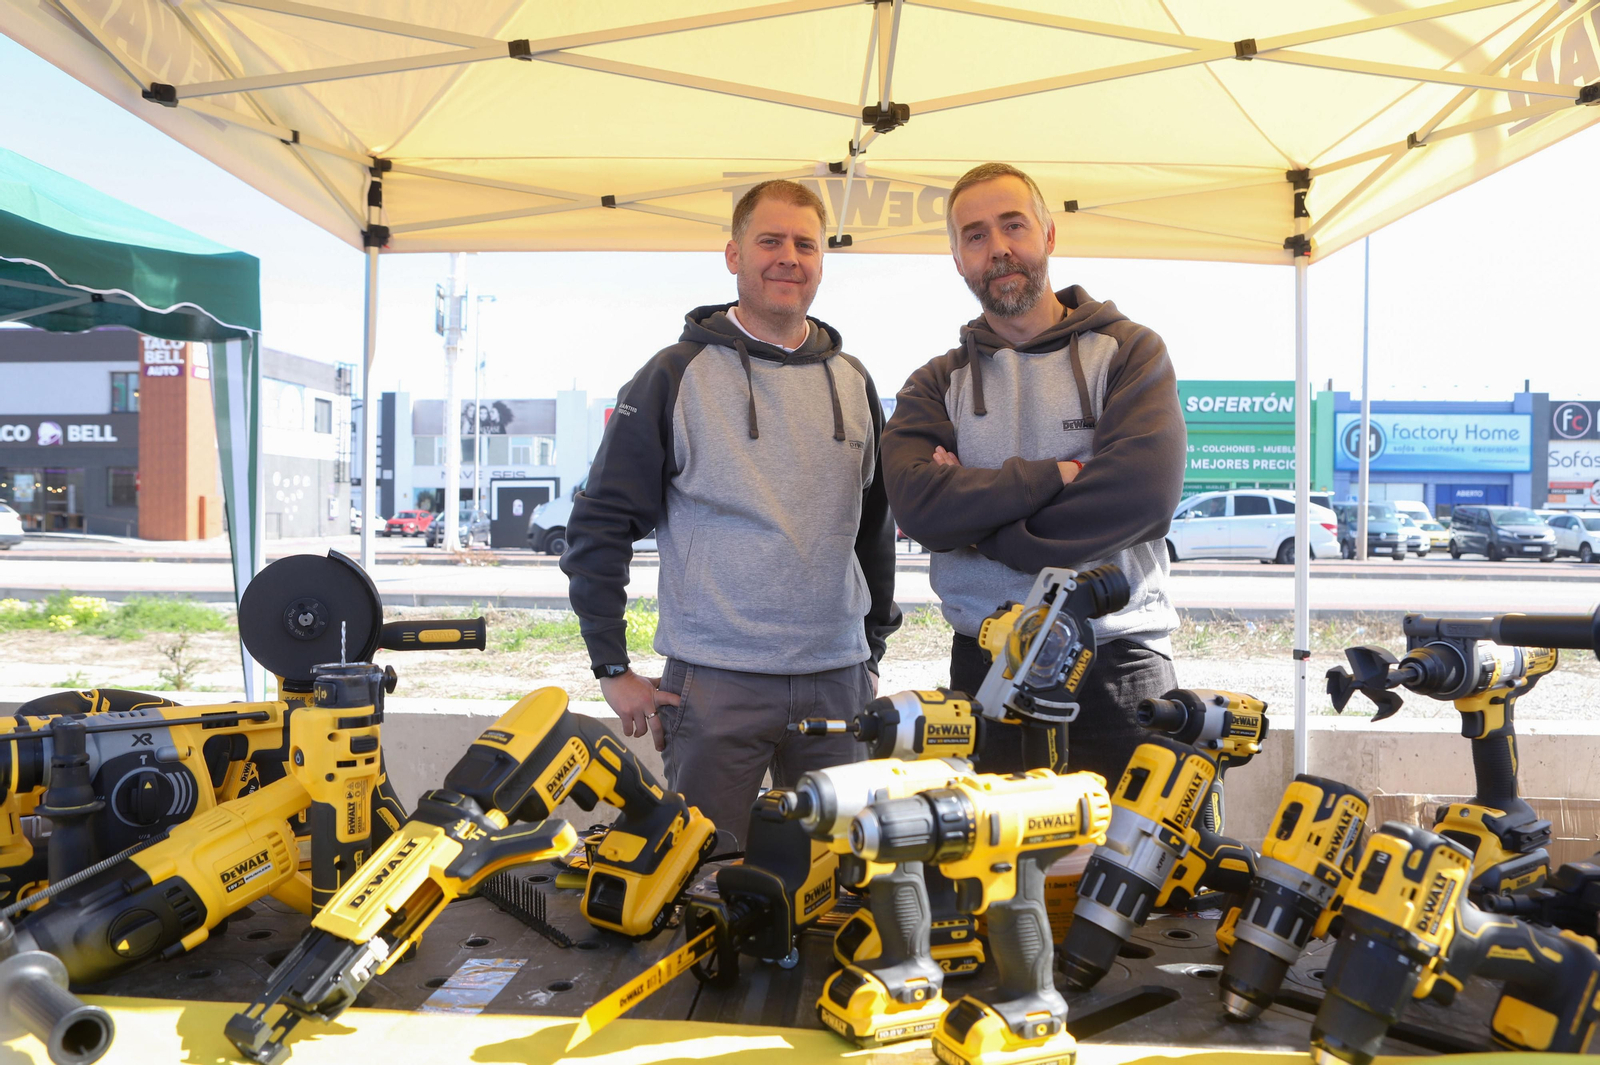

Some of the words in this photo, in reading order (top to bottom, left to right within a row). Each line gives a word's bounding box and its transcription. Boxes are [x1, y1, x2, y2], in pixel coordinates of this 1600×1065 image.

[147, 366, 179, 376] AUTO
[1186, 392, 1294, 413] SOFERTÓN
[0, 424, 31, 442] CO
[67, 424, 118, 442] BELL
[1393, 424, 1458, 443] factory
[1466, 424, 1520, 440] Home
[1202, 445, 1256, 453] COLCHONES
[1263, 445, 1296, 454] MUEBLE
[1191, 459, 1250, 470] MEJORES
[1064, 648, 1093, 693] DEWALT
[131, 733, 154, 747] XR
[928, 724, 972, 735] DEWALT
[545, 753, 577, 793] DEWALT
[1174, 772, 1205, 824] DEWALT
[347, 802, 356, 835] DEWALT
[1028, 815, 1077, 829] DEWALT
[1325, 809, 1353, 861] DEWALT
[220, 850, 269, 885] DEWALT
[349, 838, 418, 909] DEWALT
[804, 877, 832, 906] DEWALT
[1418, 871, 1449, 932] DEWALT
[653, 911, 665, 927] 18V
